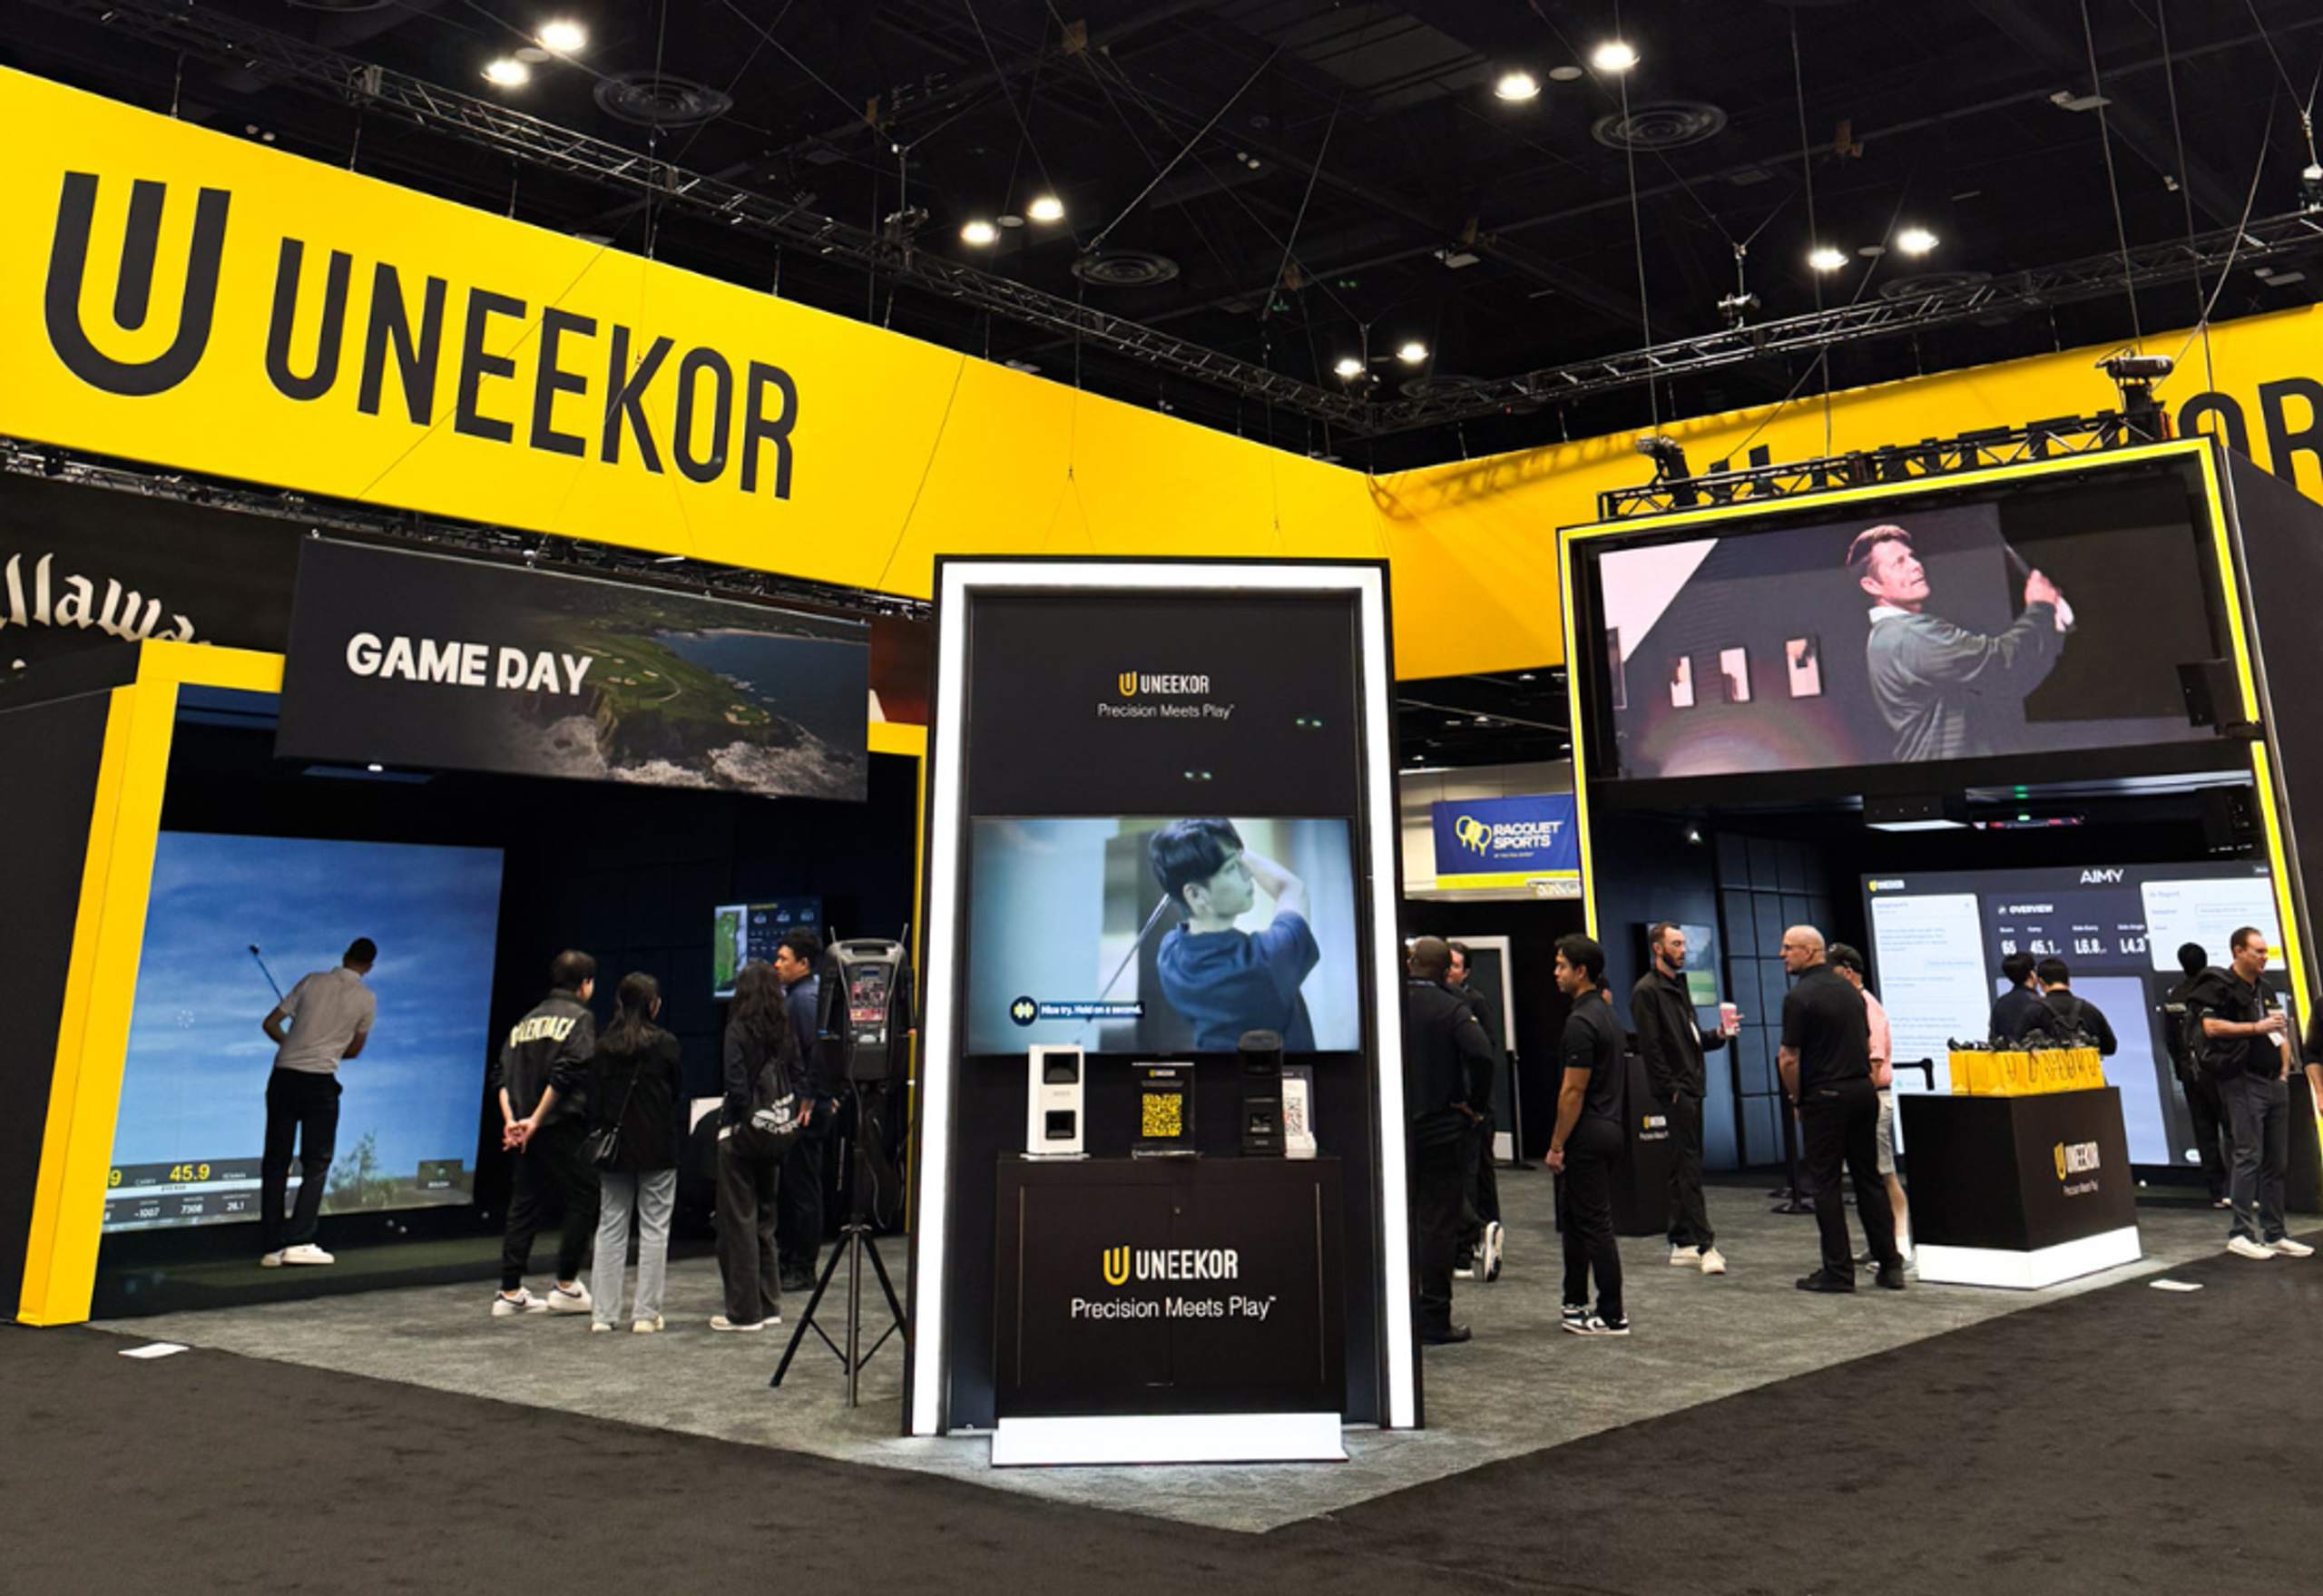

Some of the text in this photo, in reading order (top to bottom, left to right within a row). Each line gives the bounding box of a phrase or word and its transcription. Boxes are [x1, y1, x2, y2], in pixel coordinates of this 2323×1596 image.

[265, 236, 799, 501] UNEEKOR
[346, 632, 593, 696] GAME DAY
[1140, 674, 1210, 694] UNEEKOR
[1098, 703, 1157, 718] Precision
[1160, 703, 1201, 718] Meets
[1494, 821, 1563, 836] RACQUET
[1494, 835, 1551, 849] SPORTS
[2080, 868, 2124, 885] AIMY
[2008, 904, 2053, 915] OVERVIEW
[170, 1163, 211, 1181] 45.9
[1135, 1248, 1239, 1280] UNEEKOR
[1071, 1297, 1160, 1319] Precision
[1165, 1297, 1224, 1318] Meets
